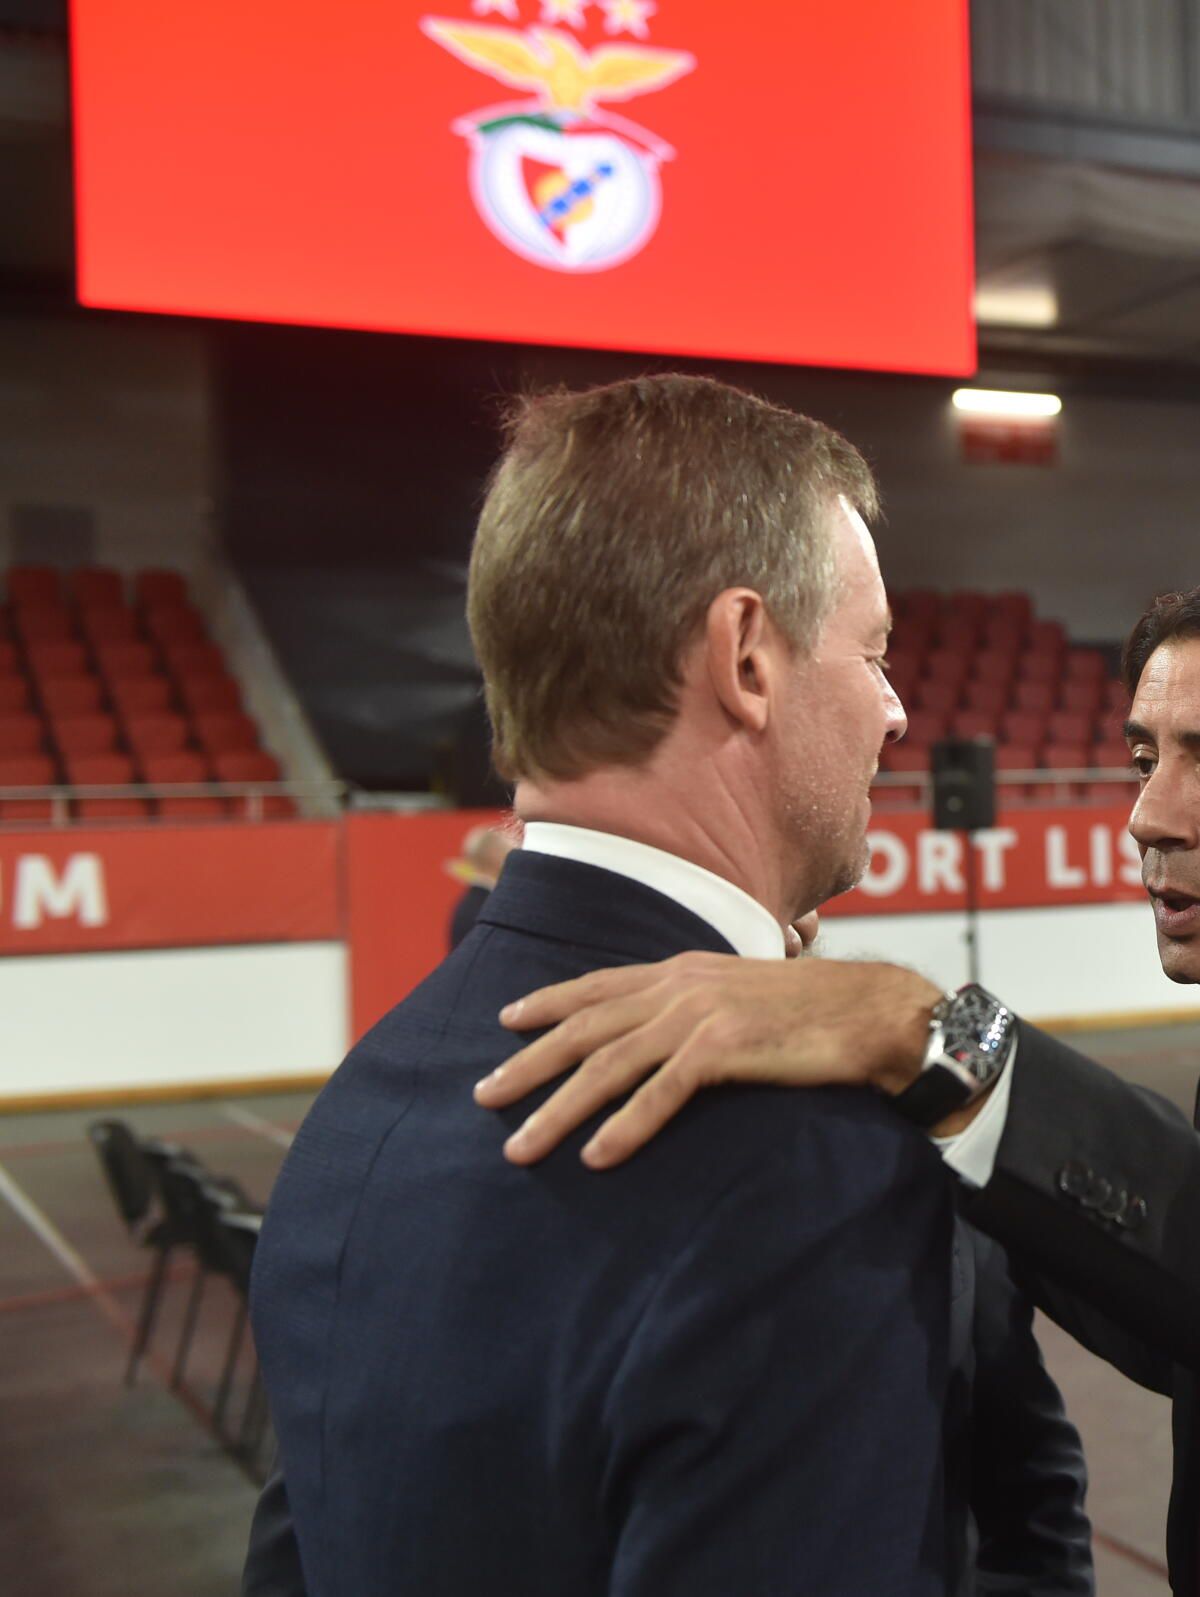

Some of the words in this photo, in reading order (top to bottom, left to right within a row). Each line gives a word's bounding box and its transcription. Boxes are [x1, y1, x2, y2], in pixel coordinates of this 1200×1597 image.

[0, 852, 109, 931] M
[857, 826, 1018, 897] ORT
[1045, 824, 1143, 888] LIS
